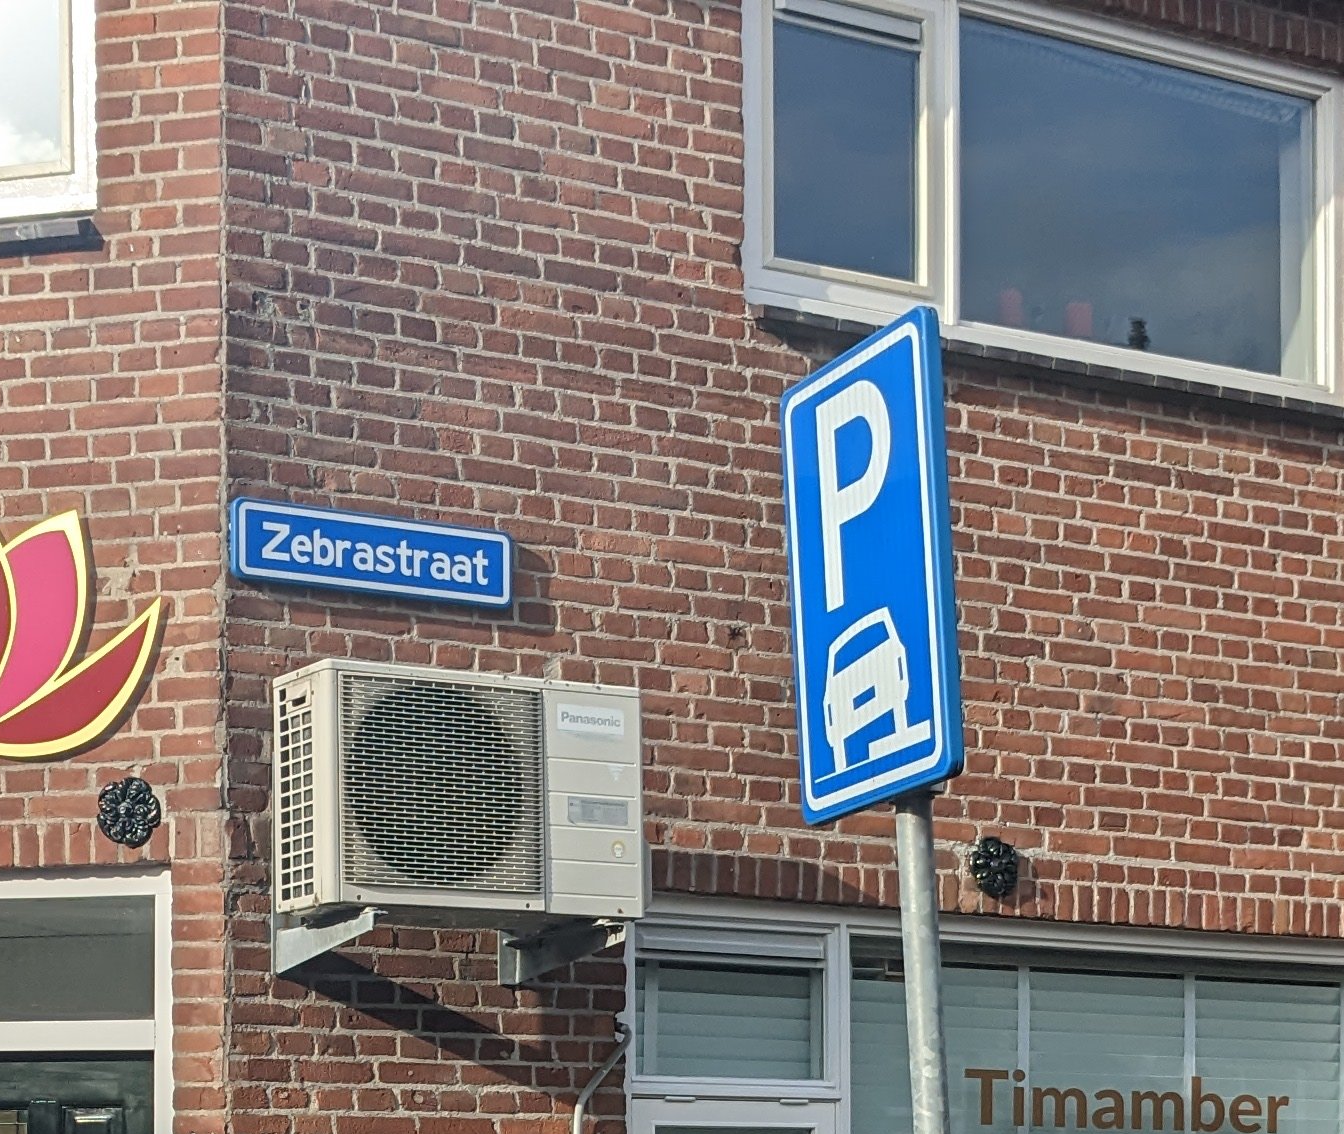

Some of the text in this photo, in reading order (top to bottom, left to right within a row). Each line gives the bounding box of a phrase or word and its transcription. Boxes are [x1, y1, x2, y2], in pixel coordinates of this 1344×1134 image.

[816, 380, 890, 613] P
[262, 521, 489, 586] Zebrastraat
[560, 711, 621, 728] Panasonic
[964, 1068, 1290, 1134] Timamber
